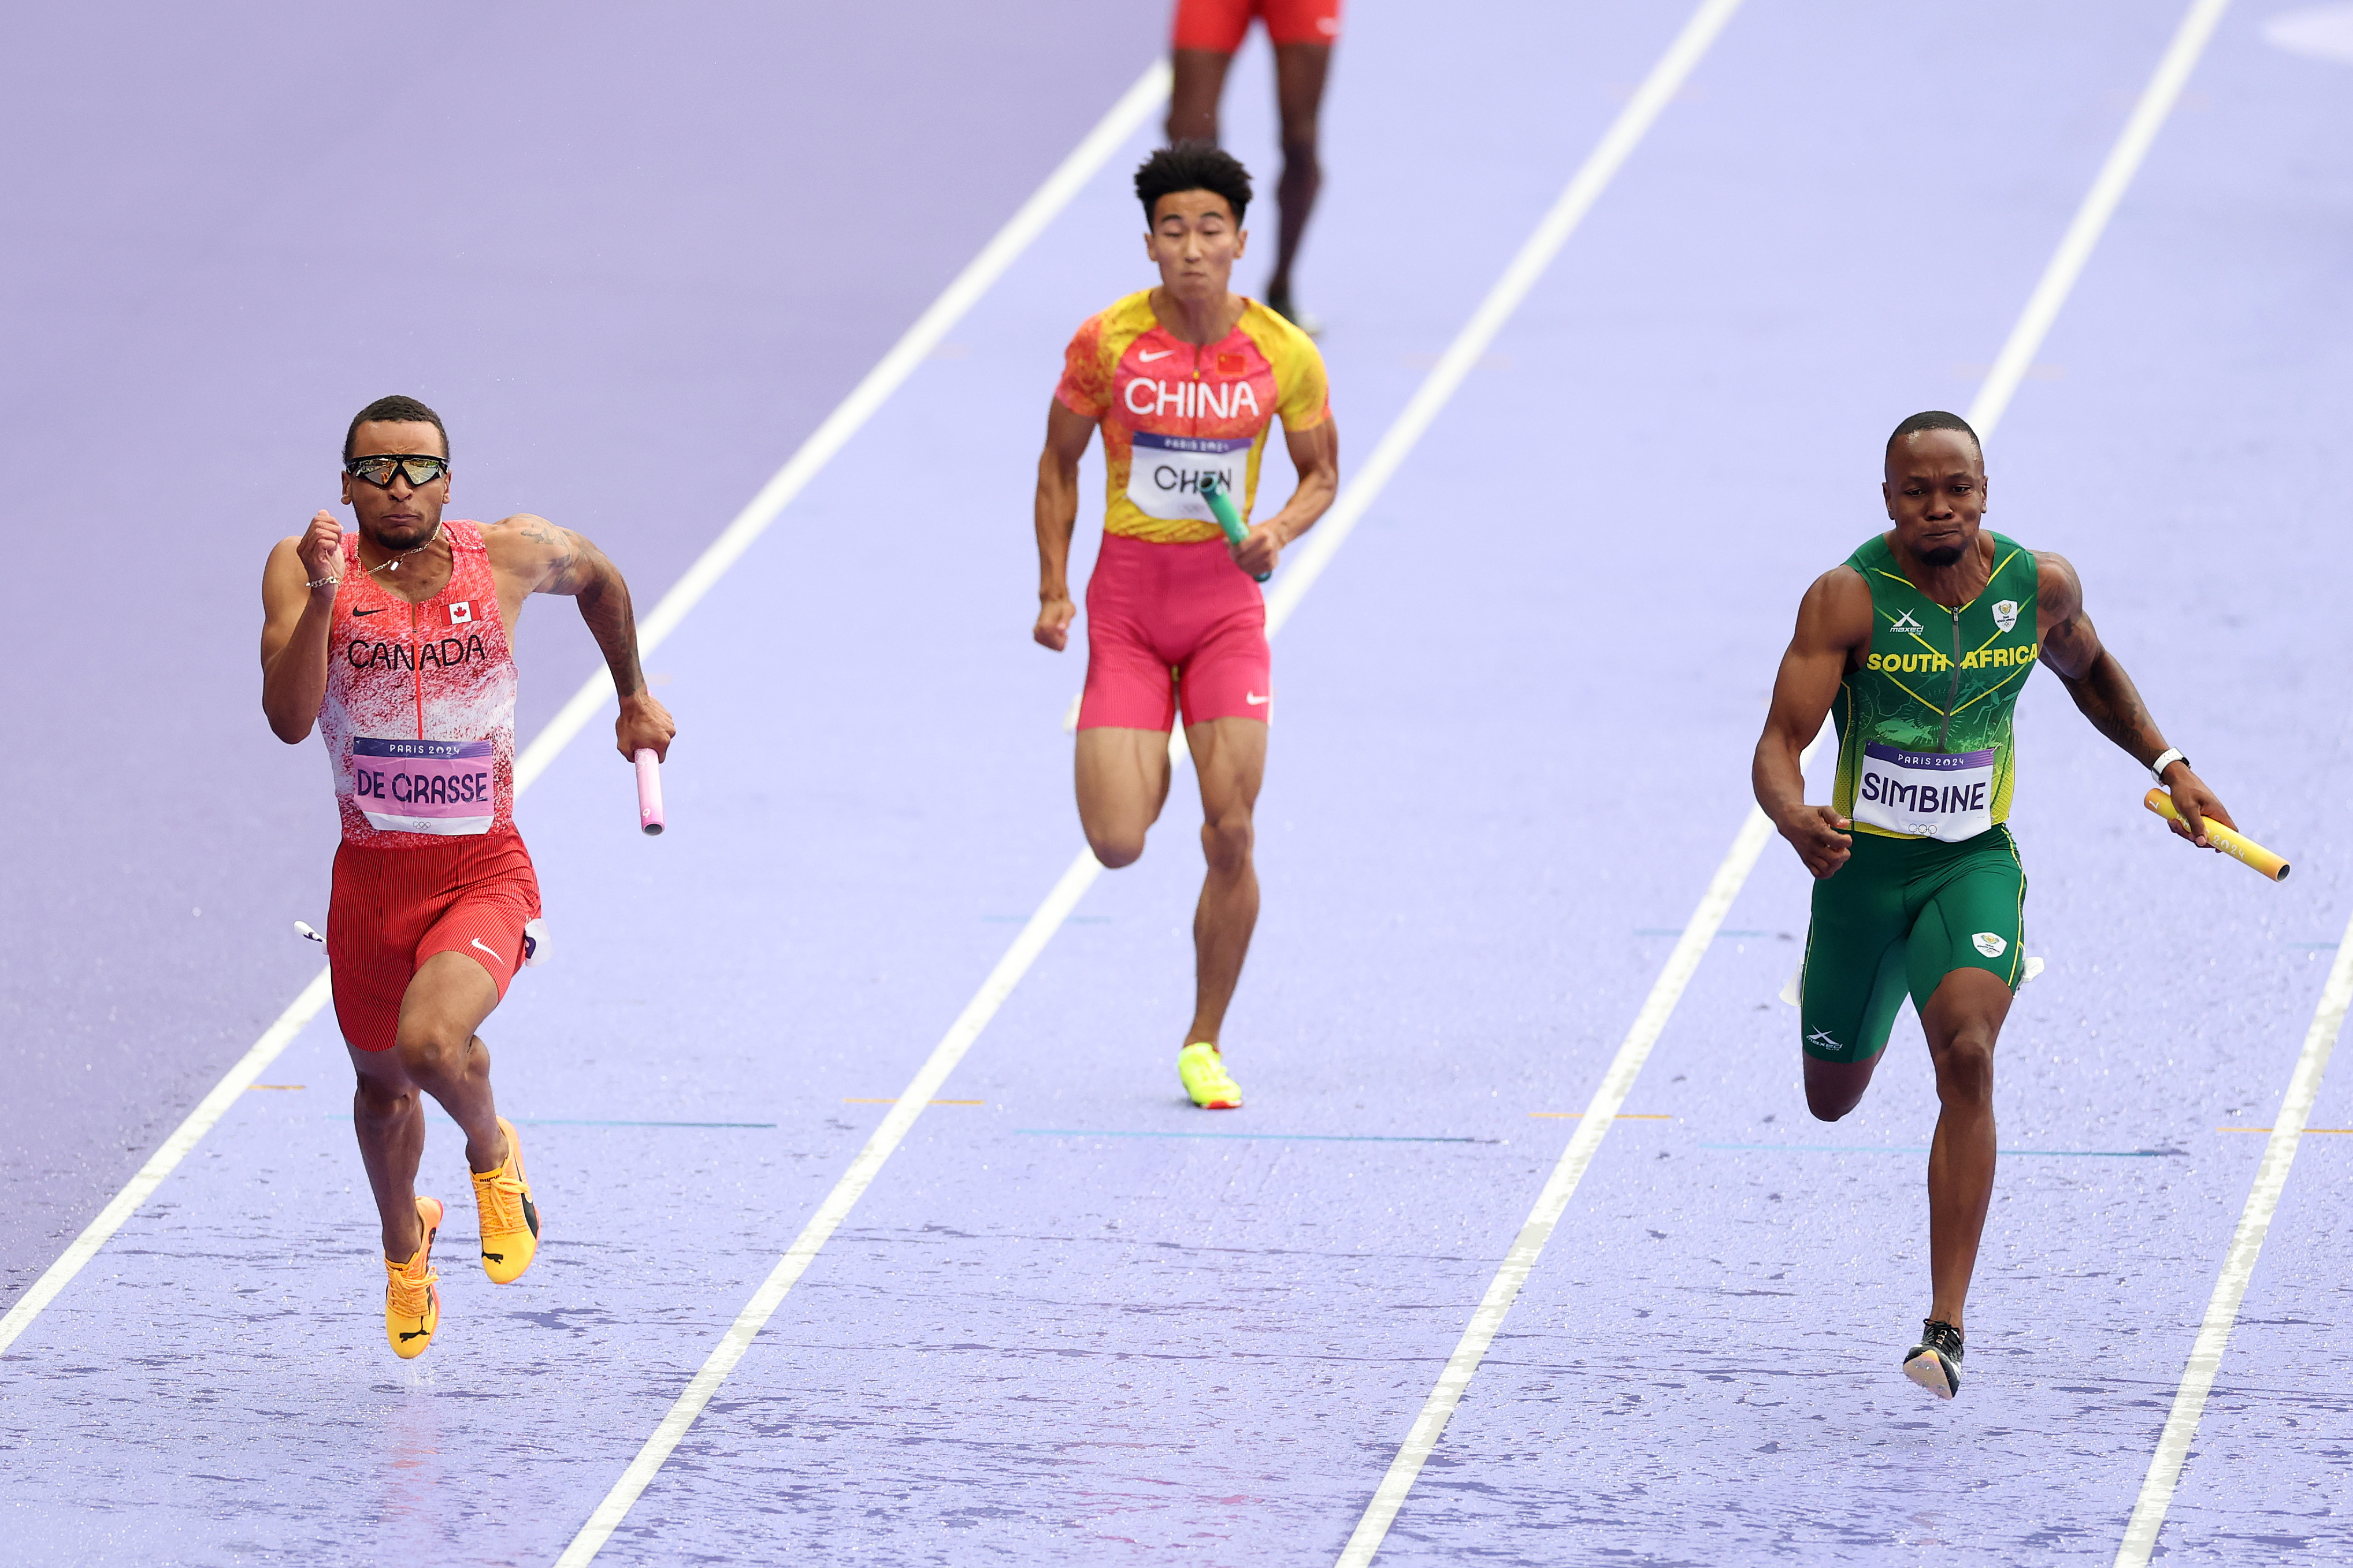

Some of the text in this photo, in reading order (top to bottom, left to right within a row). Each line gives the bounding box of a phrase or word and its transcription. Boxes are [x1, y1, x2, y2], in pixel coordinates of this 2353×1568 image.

[1124, 377, 1260, 418] CHINA
[1155, 465, 1231, 493] CHN
[348, 634, 485, 671] CANADA
[1867, 643, 2037, 672] SOUTH AFRICA
[428, 746, 460, 755] 2024
[1935, 758, 1964, 766] 2024
[358, 769, 488, 804] DE GRASSE
[1862, 772, 1986, 813] SIMBINE
[643, 808, 651, 818] 9
[2148, 800, 2159, 809] 7
[2213, 835, 2245, 859] 2024
